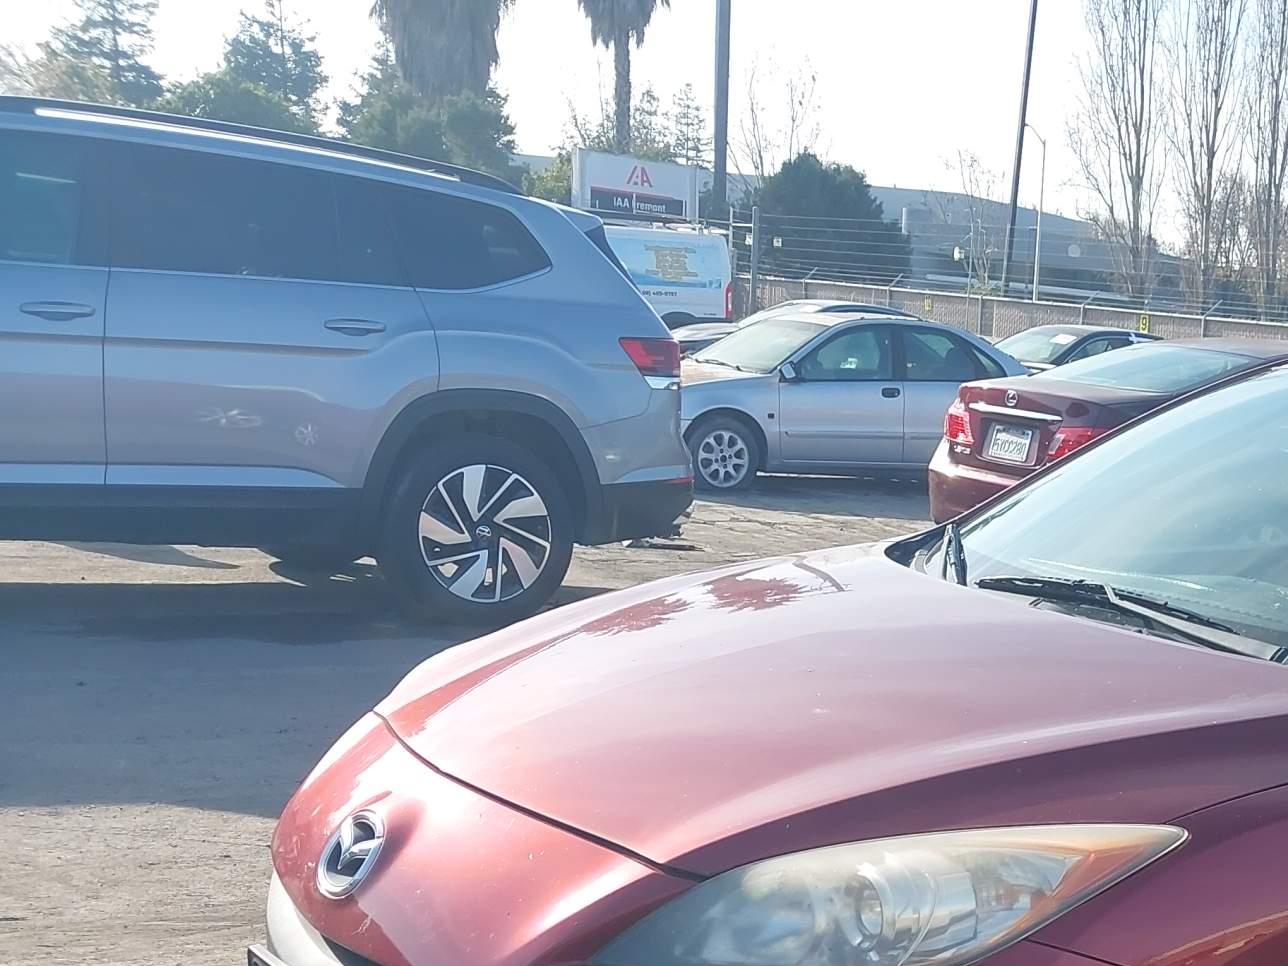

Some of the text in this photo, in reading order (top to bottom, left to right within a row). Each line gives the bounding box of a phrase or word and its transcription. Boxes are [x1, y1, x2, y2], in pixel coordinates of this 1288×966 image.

[613, 197, 666, 213] IAA remont
[1141, 316, 1148, 331] 9
